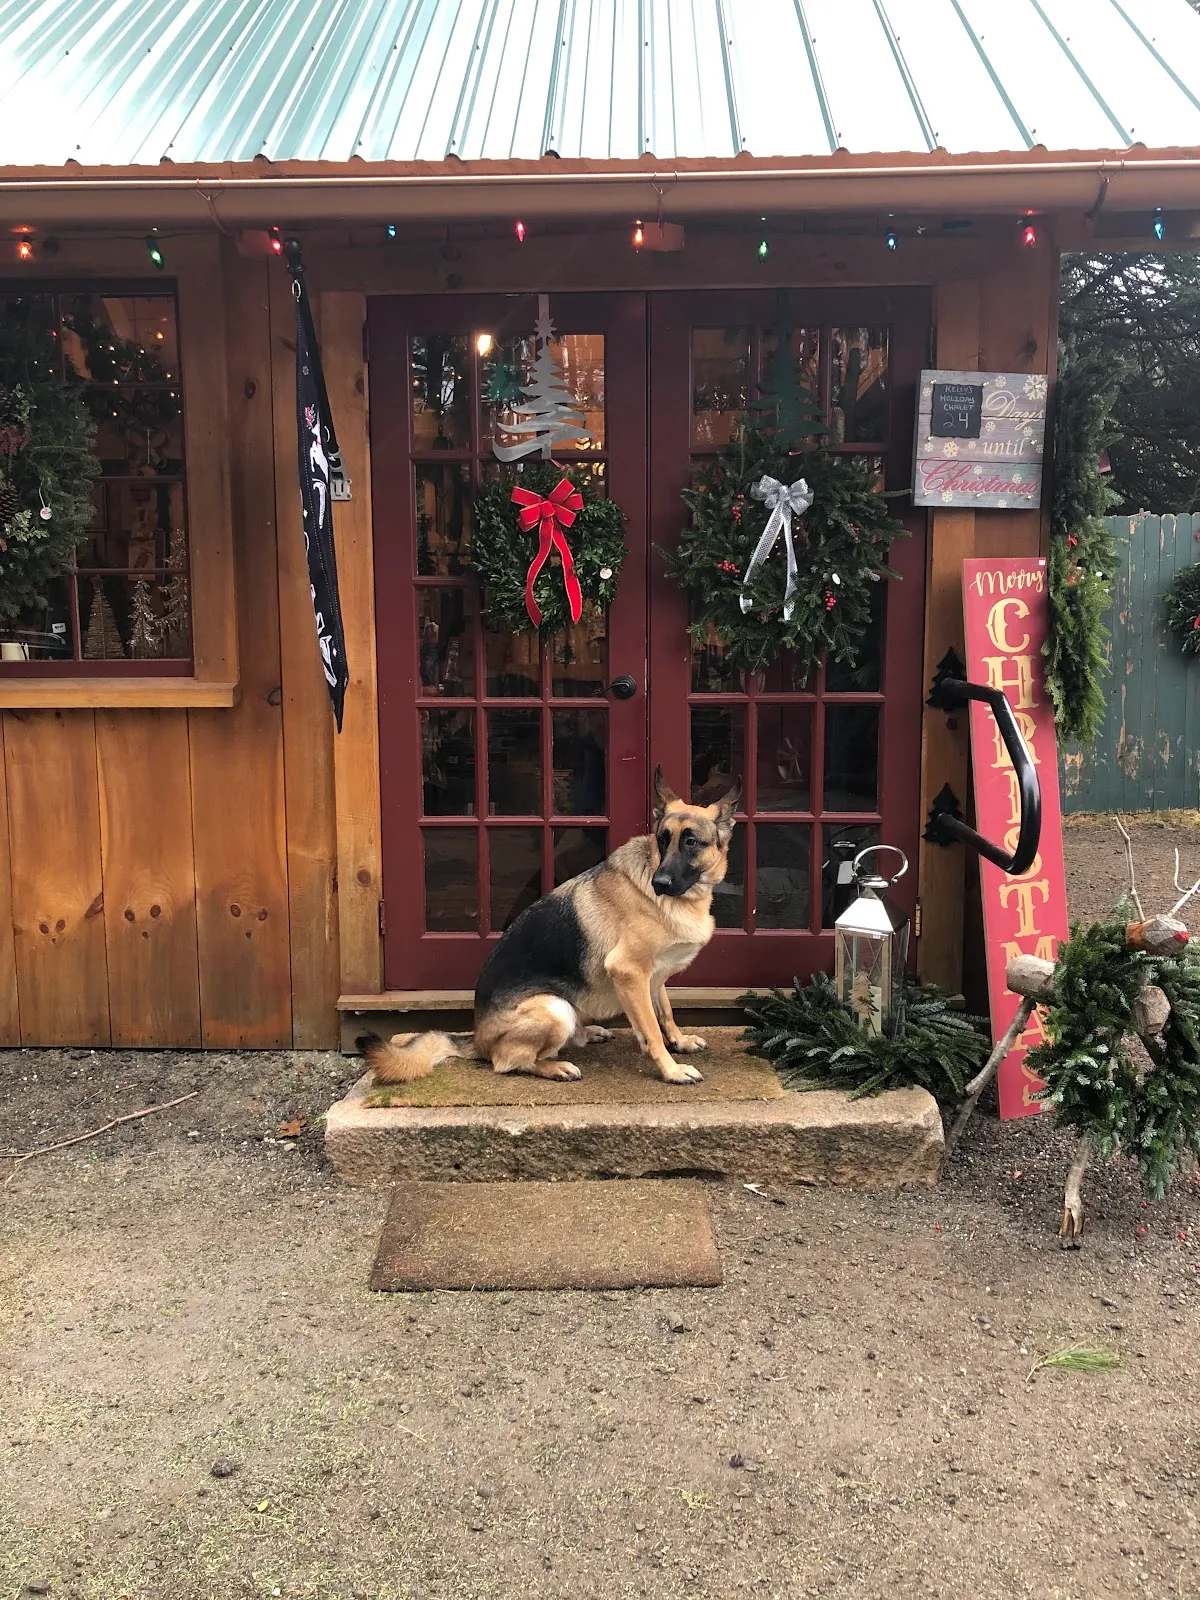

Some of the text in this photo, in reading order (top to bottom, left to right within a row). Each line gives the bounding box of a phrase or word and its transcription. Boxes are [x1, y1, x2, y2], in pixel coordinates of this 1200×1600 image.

[943, 412, 969, 430] 24
[985, 390, 1044, 431] Days
[983, 439, 1027, 456] until
[920, 457, 1039, 494] Christmas
